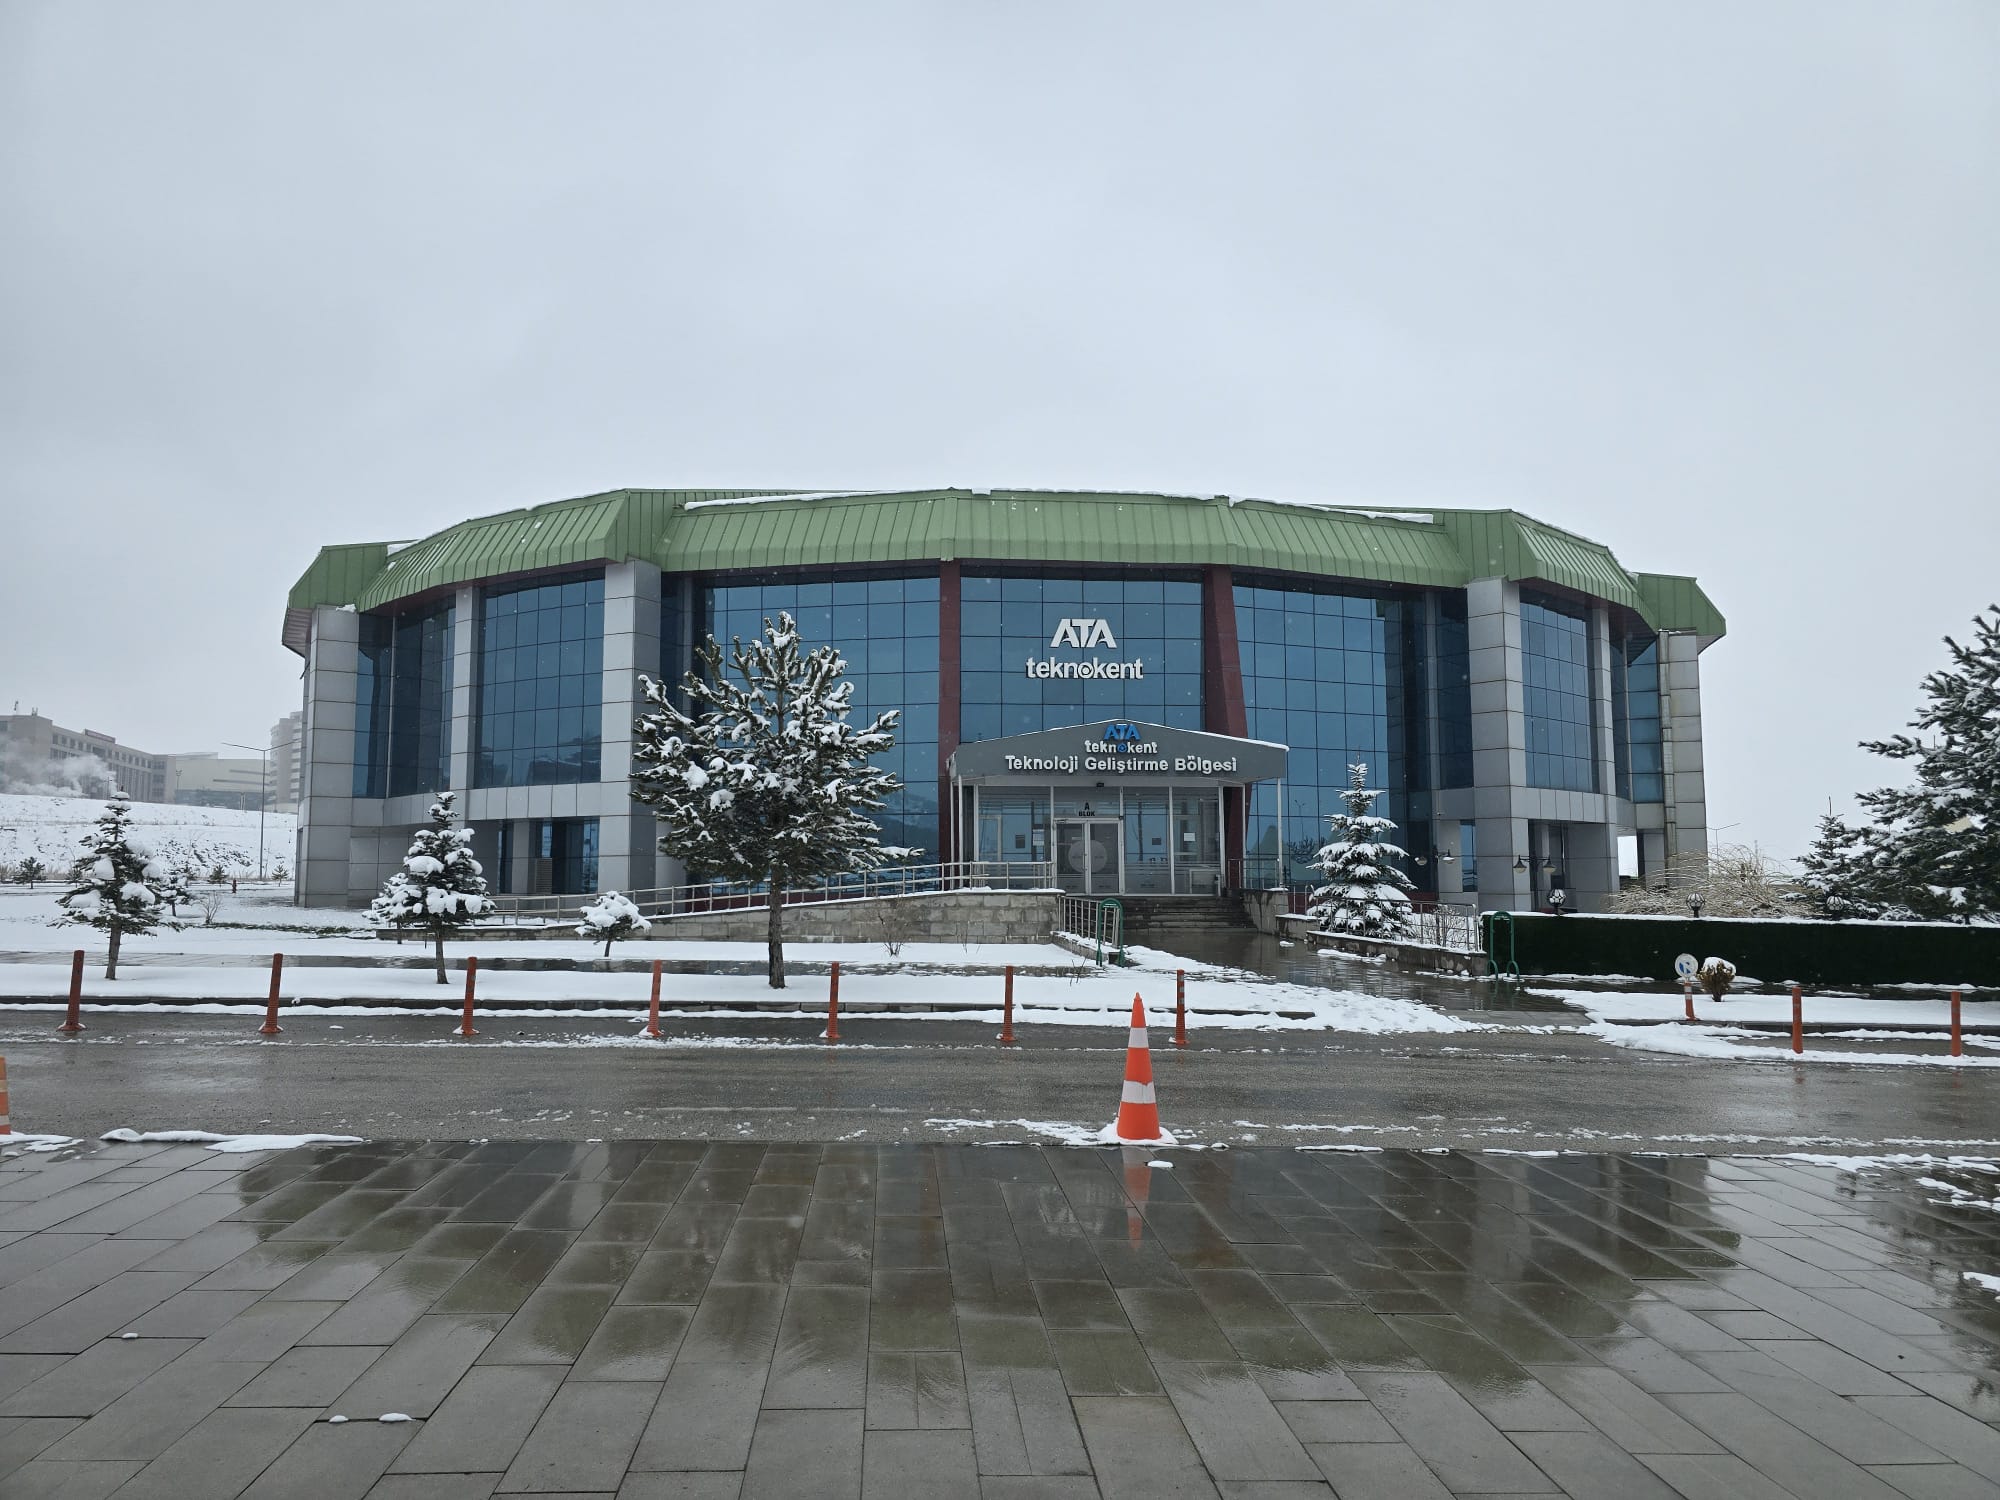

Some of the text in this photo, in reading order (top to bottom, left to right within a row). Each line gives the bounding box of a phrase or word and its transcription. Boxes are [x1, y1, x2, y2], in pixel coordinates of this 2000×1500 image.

[1050, 618, 1118, 648] ATA
[1026, 656, 1144, 679] teknokent
[1103, 723, 1142, 740] ATA
[1084, 740, 1158, 754] teknokent
[1005, 755, 1237, 775] Teknoloji Geliştirme Bölgesi
[1084, 802, 1090, 811] A
